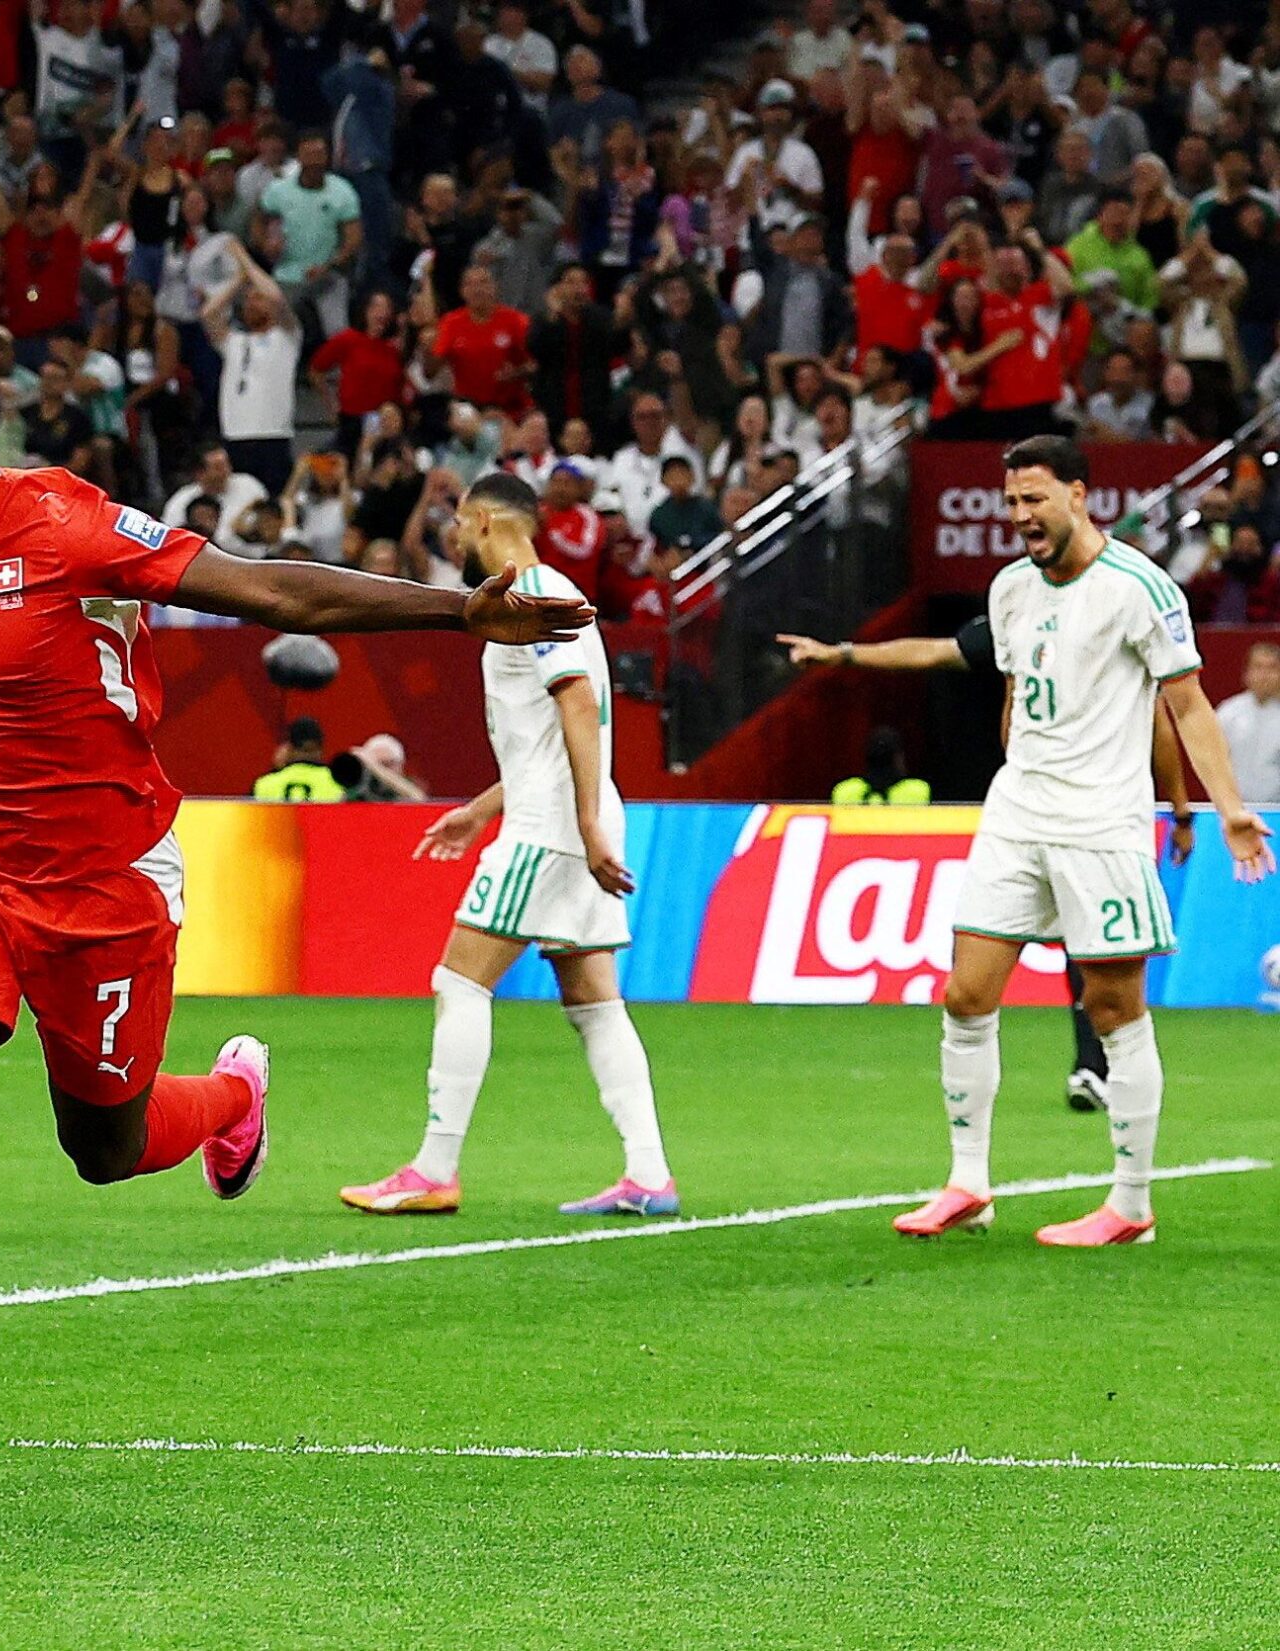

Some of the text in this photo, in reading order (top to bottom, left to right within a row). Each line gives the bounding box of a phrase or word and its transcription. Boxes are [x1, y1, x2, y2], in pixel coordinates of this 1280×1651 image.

[935, 524, 984, 556] DE
[1025, 676, 1057, 721] 21
[469, 875, 493, 914] 9
[1101, 896, 1141, 943] 21
[97, 978, 132, 1055] 7
